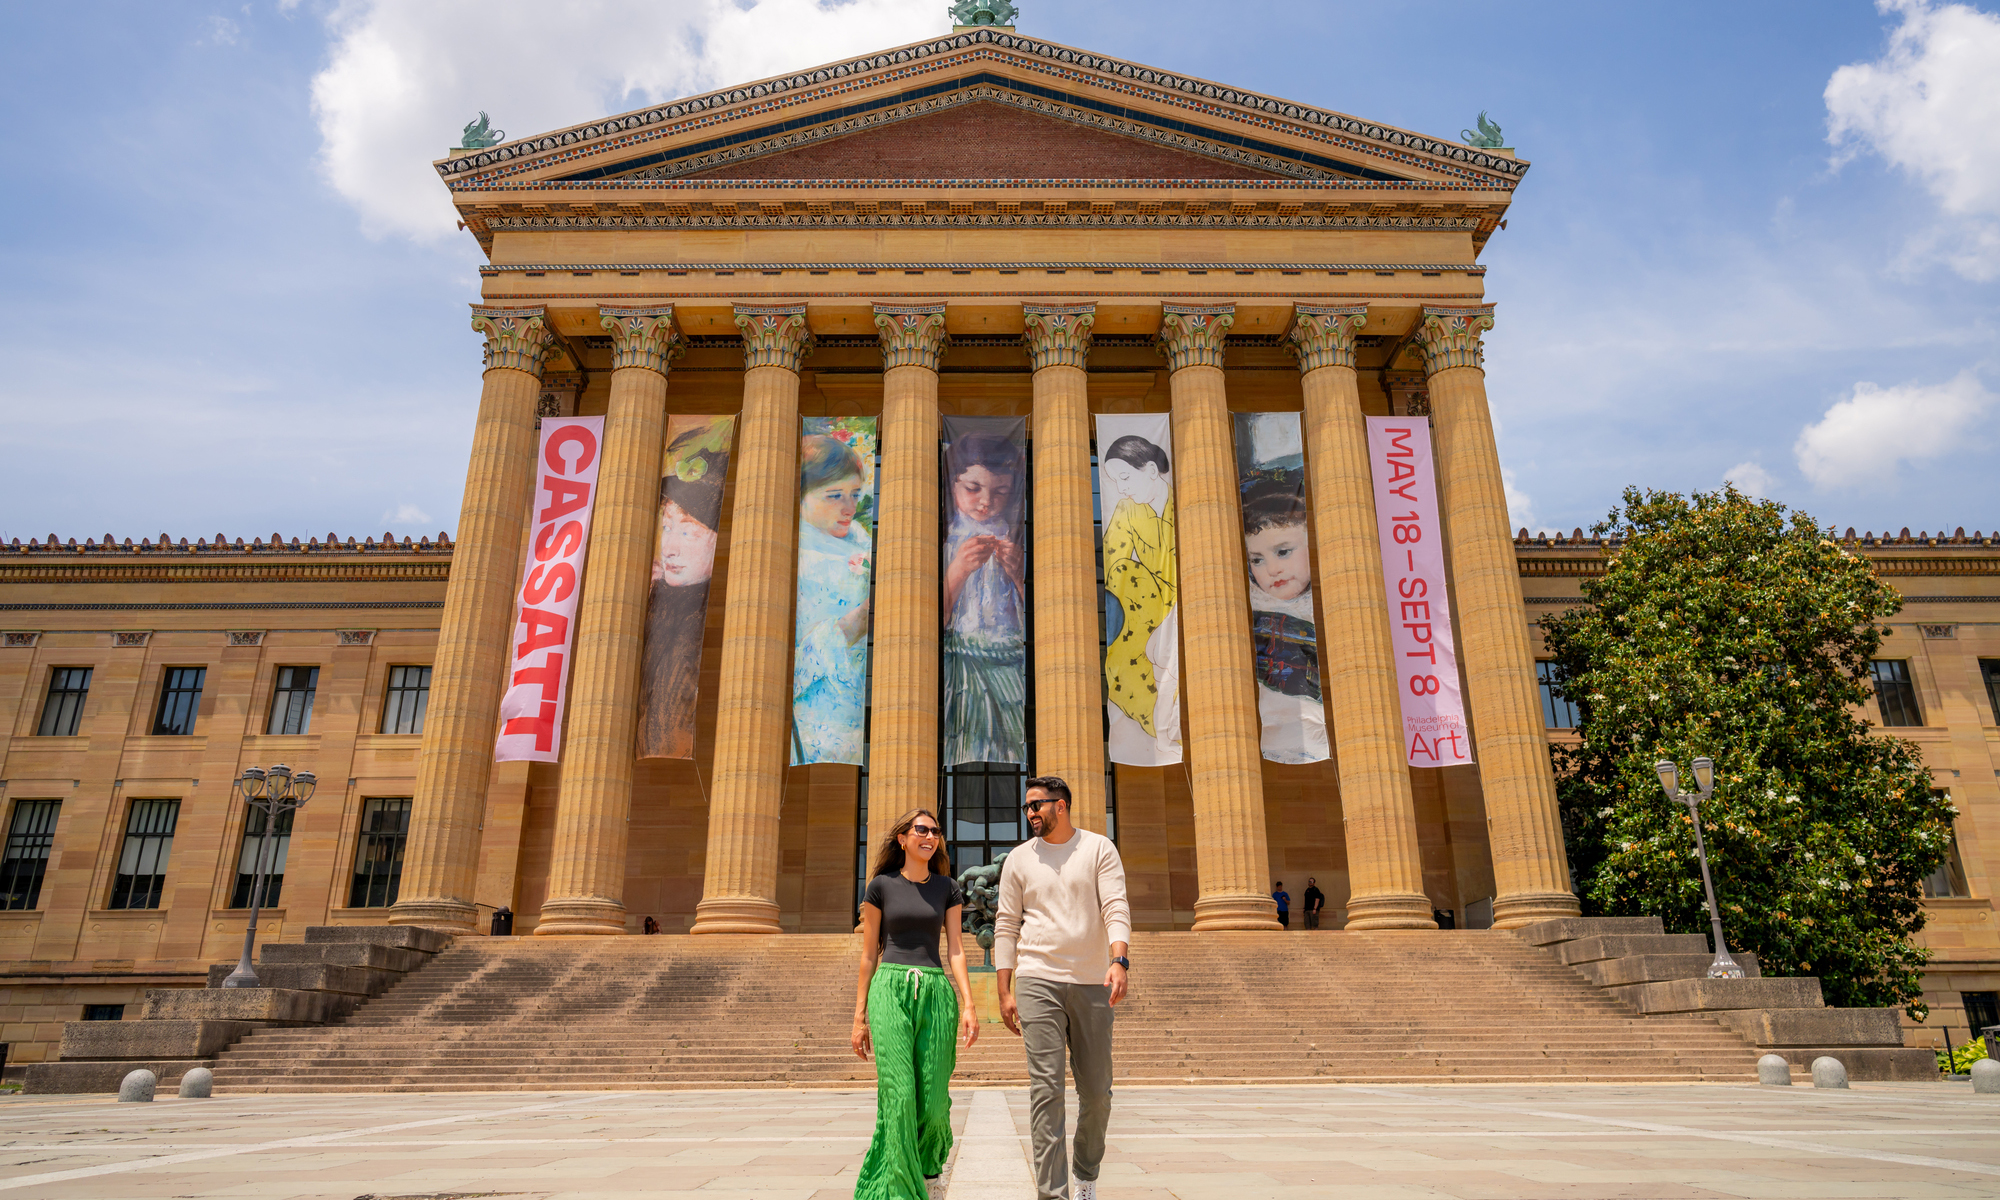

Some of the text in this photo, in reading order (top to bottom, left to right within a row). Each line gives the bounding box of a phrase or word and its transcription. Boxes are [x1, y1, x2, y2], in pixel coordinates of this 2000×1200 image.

[1384, 428, 1418, 502] MAY
[1409, 674, 1441, 697] 8
[503, 425, 597, 753] CASSATT
[1406, 714, 1460, 724] Philadelphia
[1408, 720, 1460, 732] Museum of
[1410, 730, 1465, 761] Art
